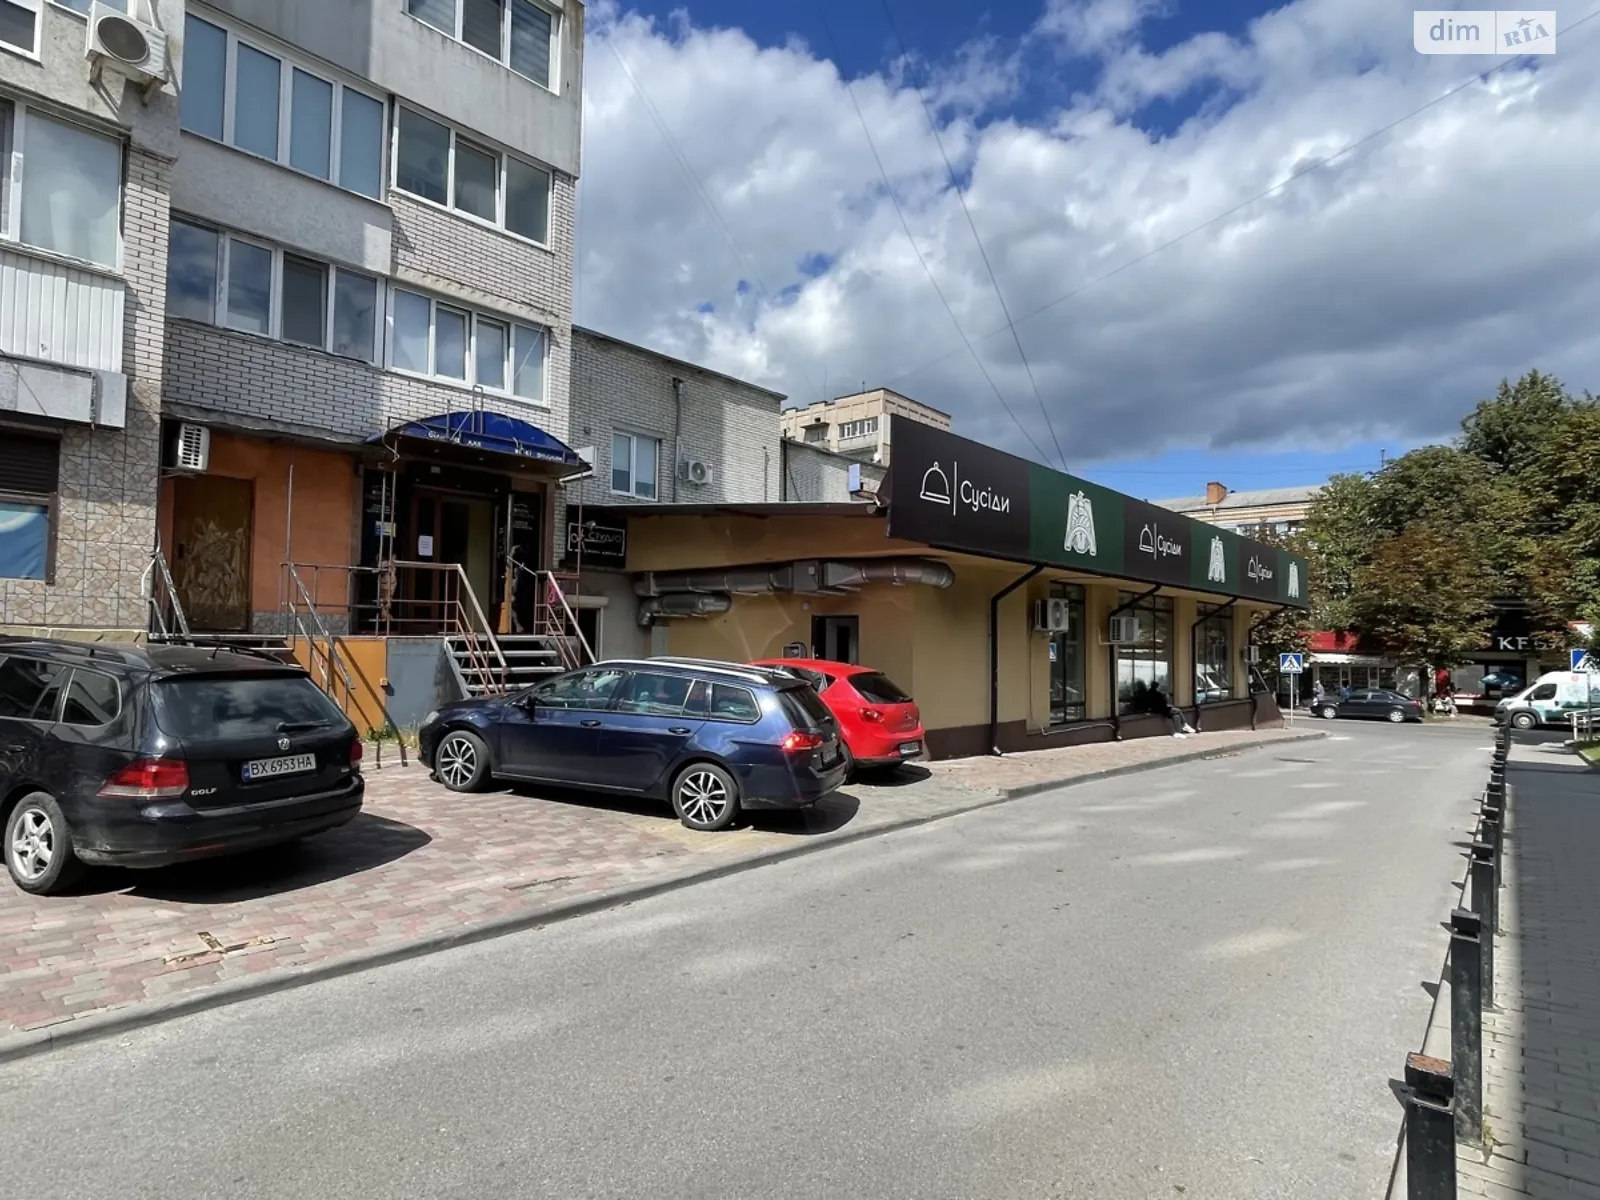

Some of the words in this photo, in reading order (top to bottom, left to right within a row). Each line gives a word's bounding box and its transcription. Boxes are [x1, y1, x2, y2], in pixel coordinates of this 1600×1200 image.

[960, 479, 1010, 514] Сусіди
[251, 762, 268, 776] BX
[270, 758, 296, 773] 6953
[297, 756, 312, 769] HA
[191, 787, 217, 796] GOLF
